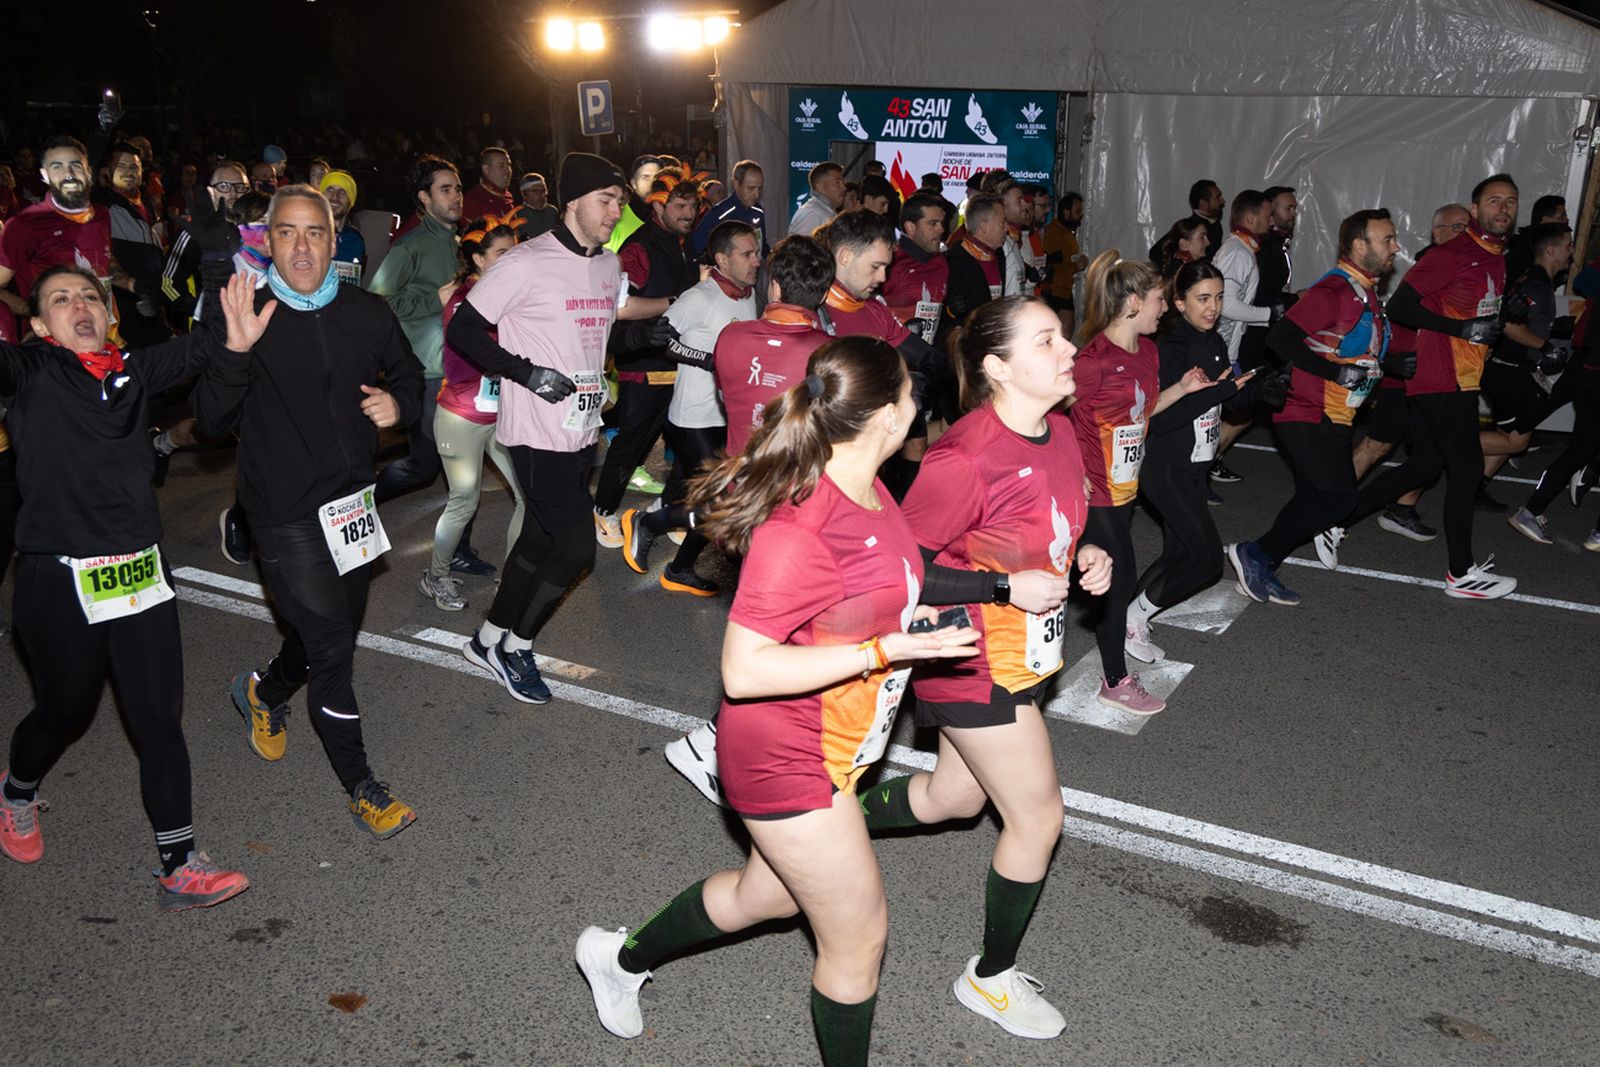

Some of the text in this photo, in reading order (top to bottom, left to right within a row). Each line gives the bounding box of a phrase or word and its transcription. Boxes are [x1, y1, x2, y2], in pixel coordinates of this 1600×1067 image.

[887, 97, 951, 118] 43 SAN
[847, 118, 859, 132] 43
[974, 121, 987, 136] 43
[941, 165, 971, 180] SAN
[337, 503, 356, 514] NOCHE
[331, 517, 345, 527] SAN
[340, 513, 375, 545] 1829
[85, 557, 105, 568] SAN
[87, 555, 154, 592] 13055
